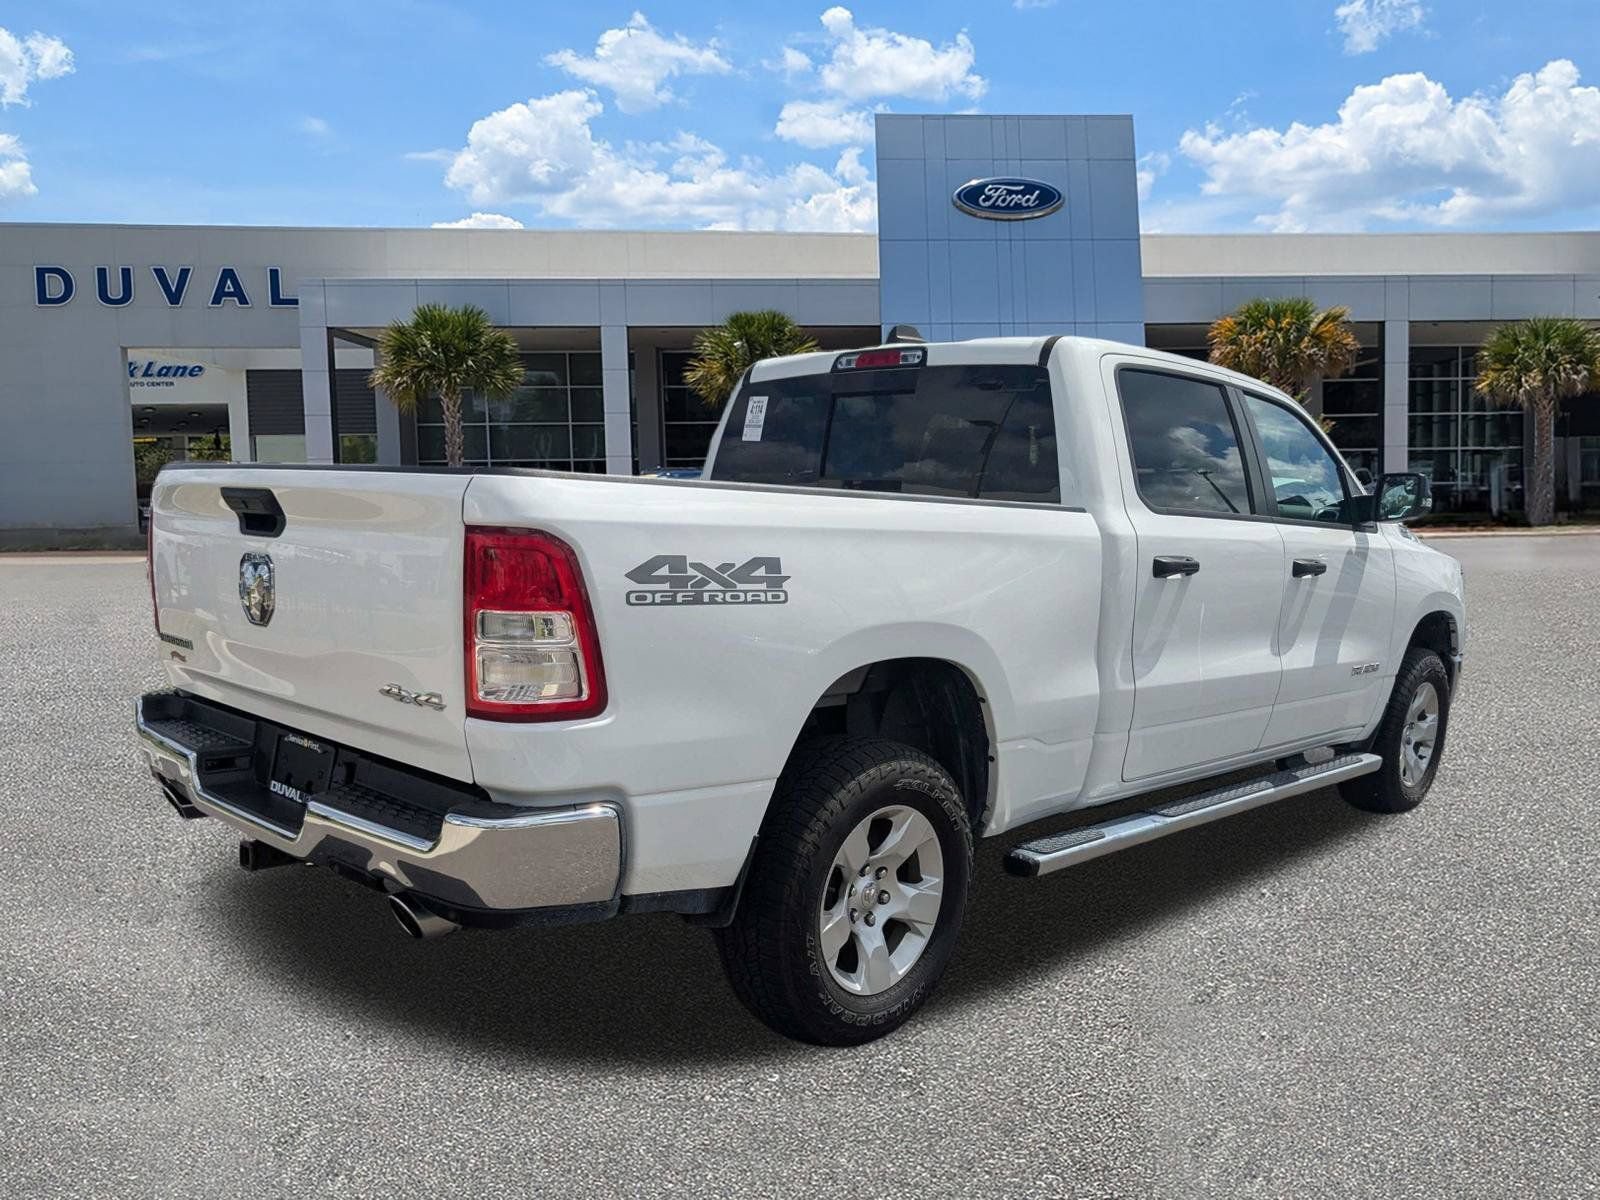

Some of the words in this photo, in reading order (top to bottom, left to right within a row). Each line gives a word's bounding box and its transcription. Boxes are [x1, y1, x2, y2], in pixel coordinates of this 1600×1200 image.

[979, 184, 1040, 207] Ford
[33, 265, 299, 307] DUVAL
[142, 361, 205, 378] Lane
[629, 592, 697, 605] OFF
[703, 592, 786, 604] ROAD
[270, 780, 302, 803] DUVAL
